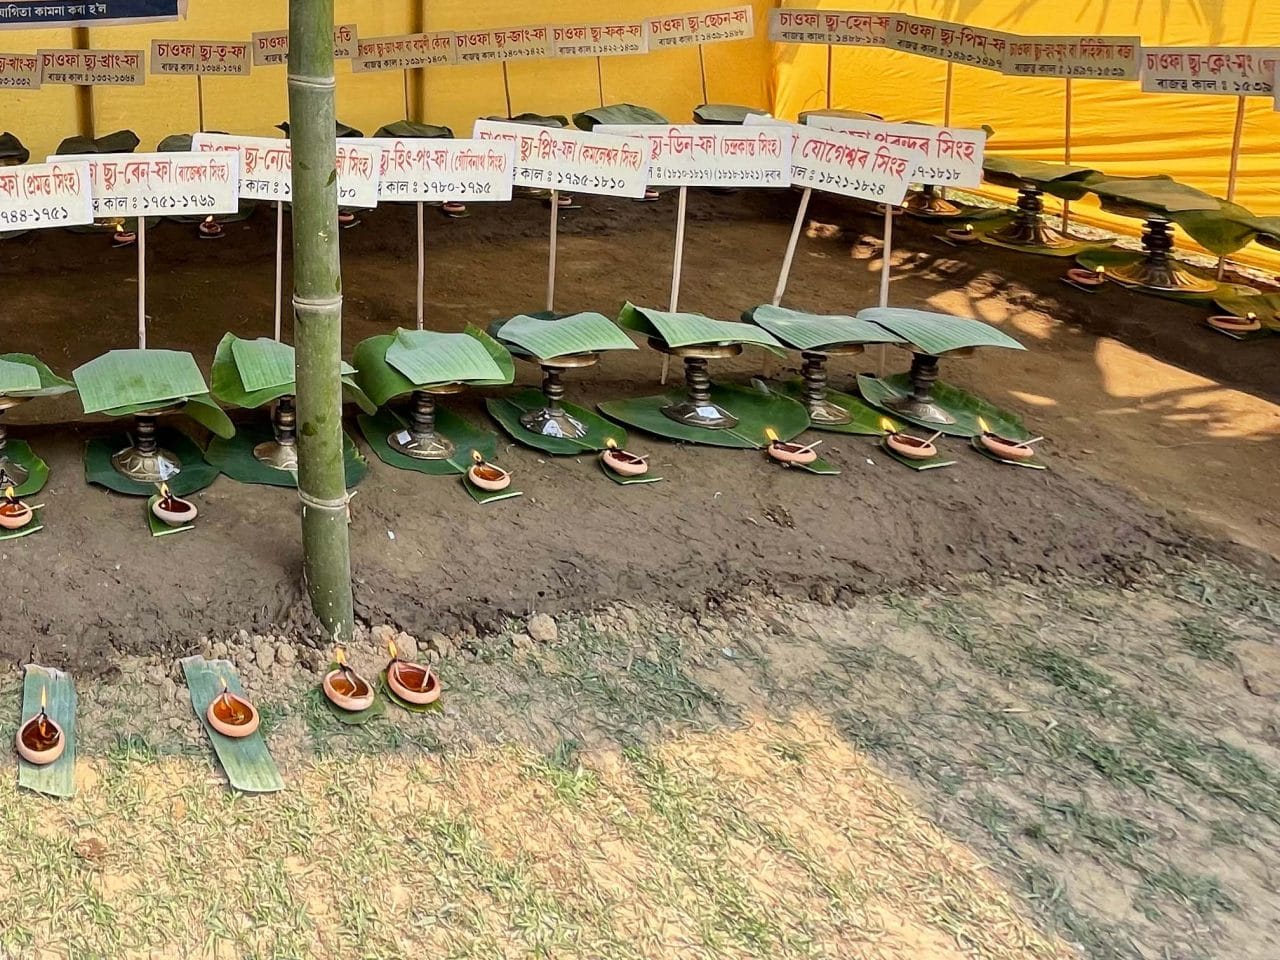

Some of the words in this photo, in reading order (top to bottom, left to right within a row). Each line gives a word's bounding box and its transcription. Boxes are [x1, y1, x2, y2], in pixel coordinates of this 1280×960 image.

[34, 6, 64, 16] কামনা
[68, 5, 85, 15] কৰা
[651, 18, 684, 35] চাওফা
[780, 12, 820, 28] চাওফা
[825, 15, 889, 36] ছ্যু-হেন্-ফ
[457, 33, 490, 48] চাওফা
[554, 27, 586, 42] চাওফা
[835, 34, 886, 45] ১৪৮৮-১৪৯
[895, 21, 935, 39] চাওফা
[940, 26, 1006, 55] ছ্যু-পিম্-ফ
[158, 43, 194, 58] চাওফা
[43, 53, 79, 68] চাওফা
[1147, 53, 1183, 71] চাওফা
[1191, 80, 1216, 90] কাল
[936, 131, 975, 163] সিংহ
[872, 146, 909, 182] সিংহ
[246, 180, 270, 194] কাল
[521, 169, 544, 181] কাল
[557, 172, 625, 189] ১৭৯৫-১৮১০
[819, 171, 885, 196] ১৮২১-১৮২৪
[386, 182, 409, 194] কাল
[423, 181, 491, 194] ১৭৮০-১৭৯৫
[104, 197, 128, 212] কাল
[143, 195, 216, 209] ১৭৫১-১৭৬৯
